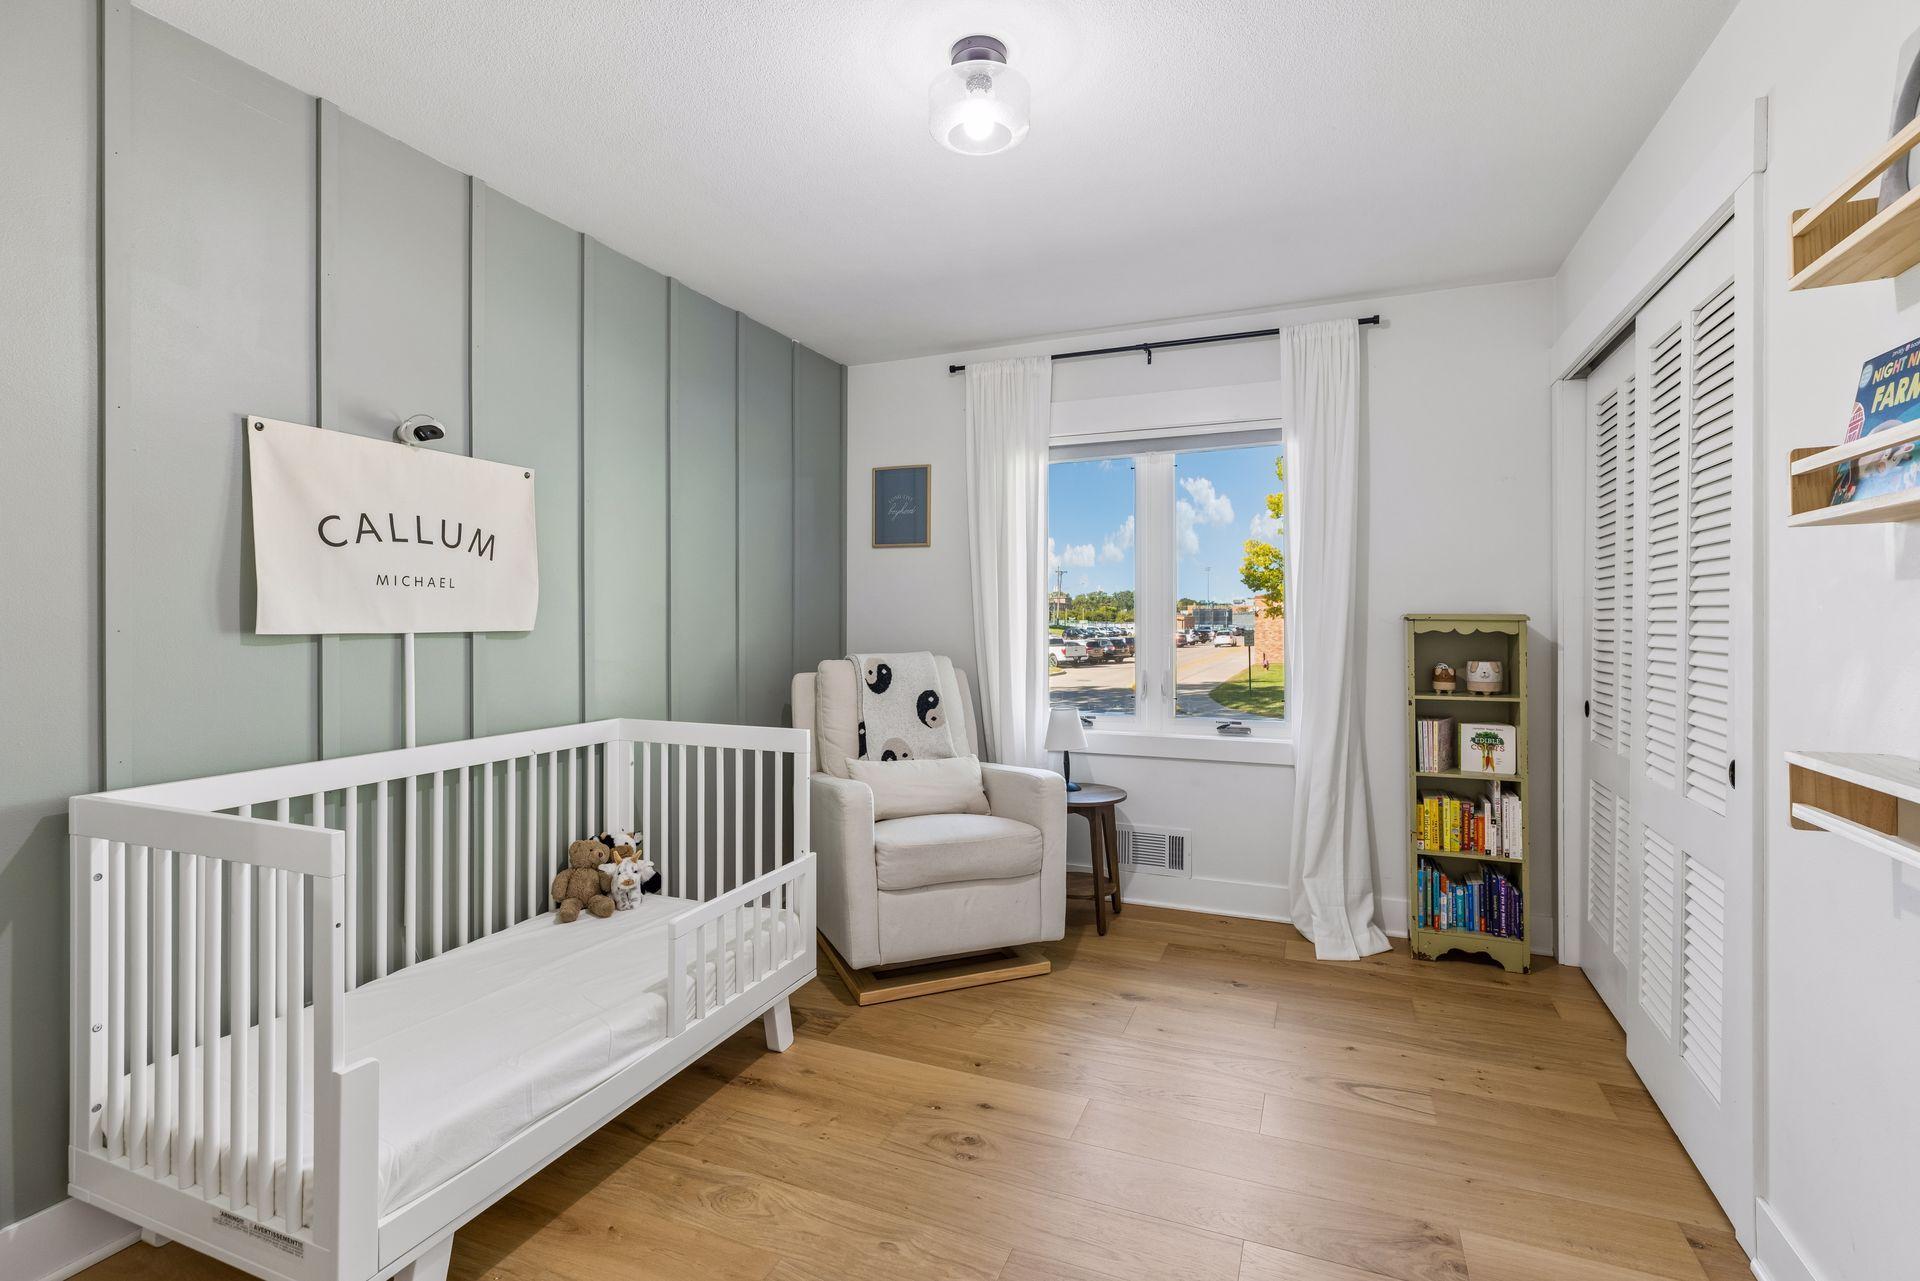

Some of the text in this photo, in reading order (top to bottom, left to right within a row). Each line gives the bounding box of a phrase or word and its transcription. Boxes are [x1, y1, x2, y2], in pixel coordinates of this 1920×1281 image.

[1872, 355, 1908, 385] NIGHT
[318, 512, 496, 561] CALLUM
[376, 574, 456, 589] MICHAEL
[1475, 737, 1501, 745] EDIBLE
